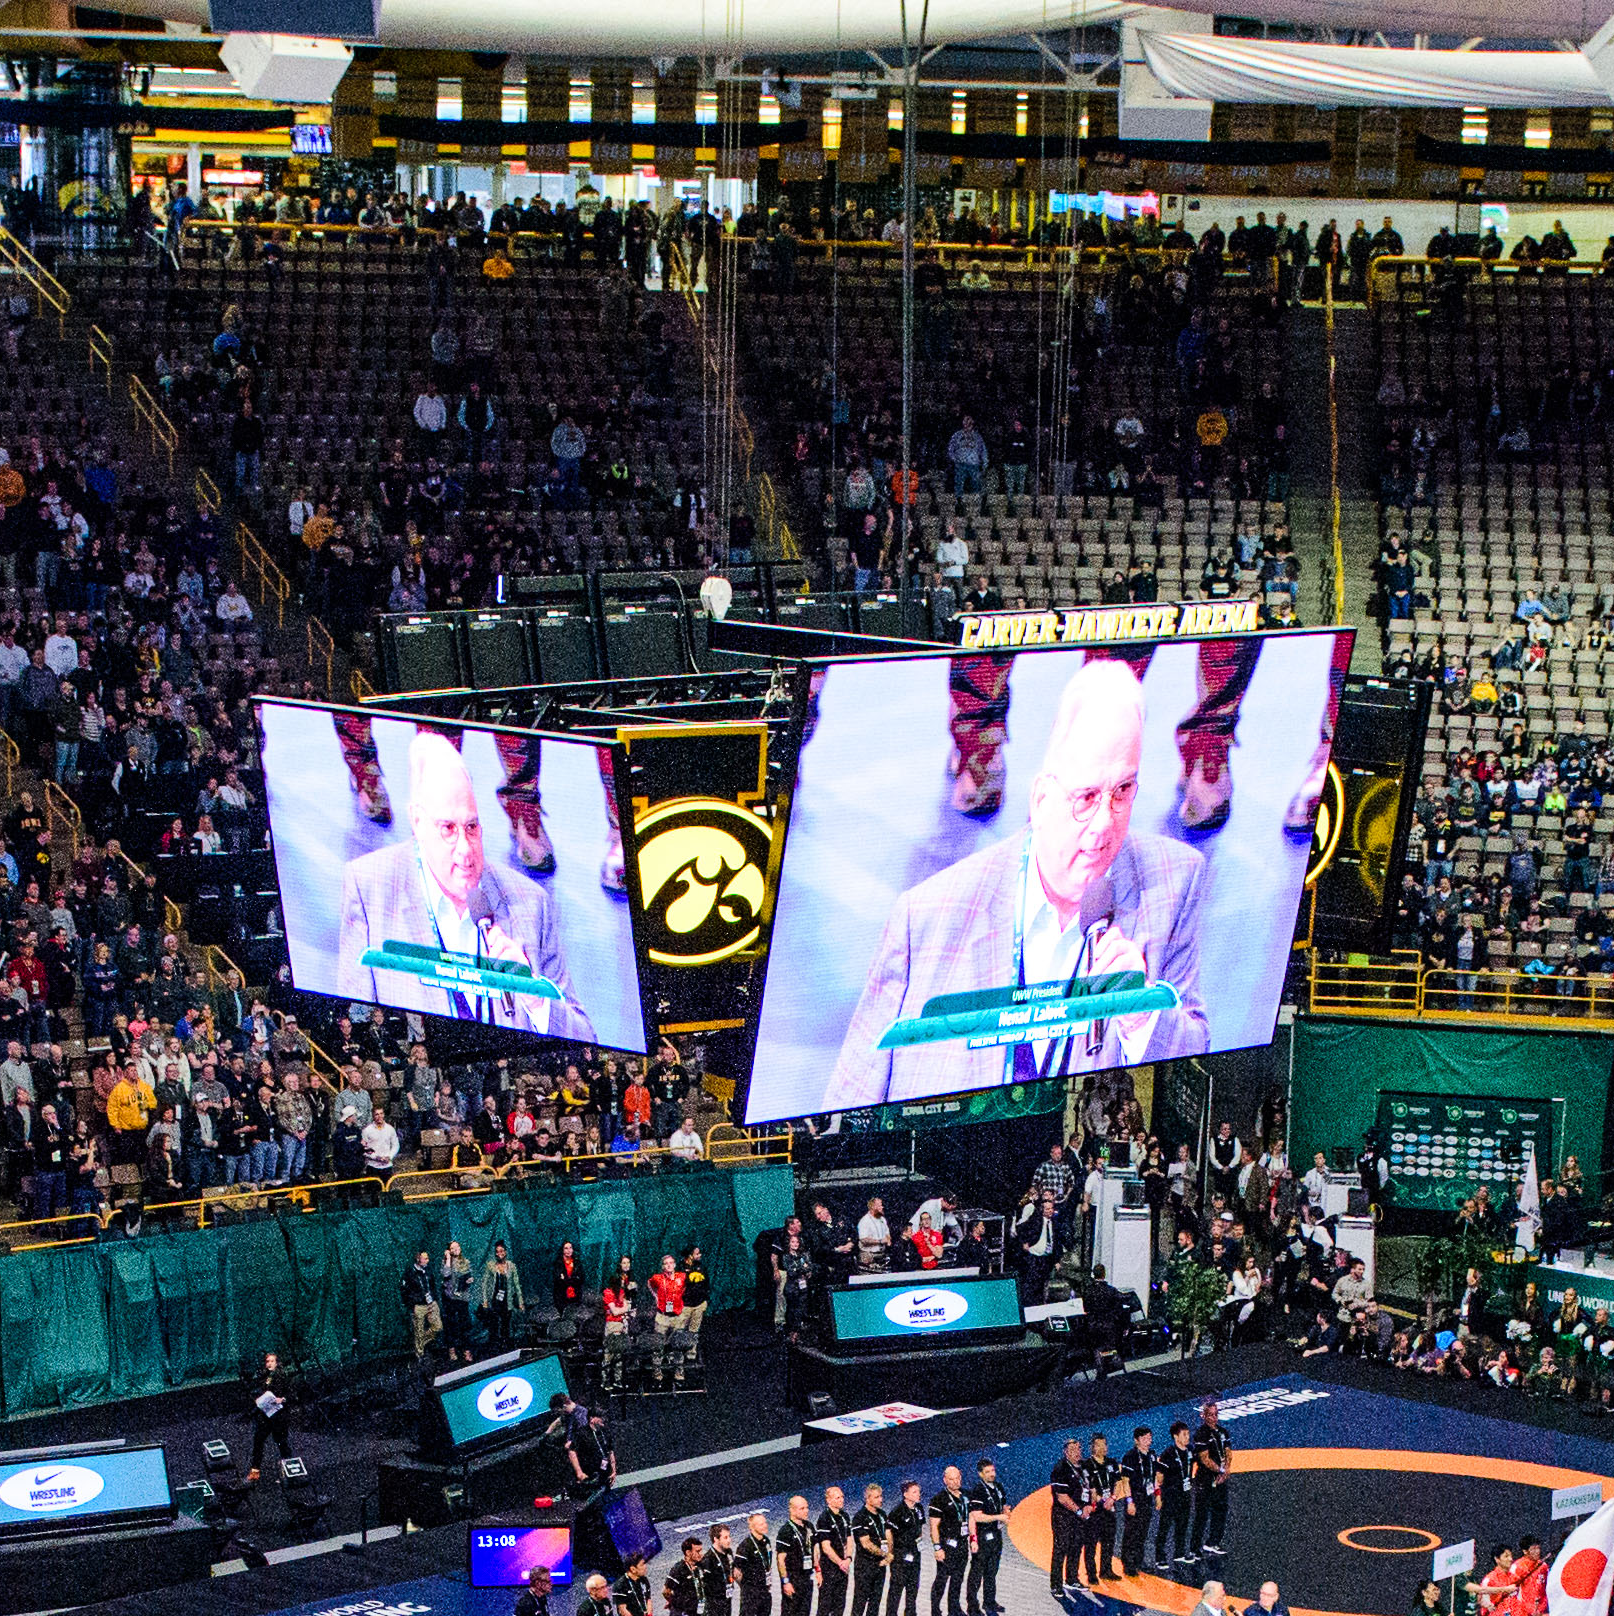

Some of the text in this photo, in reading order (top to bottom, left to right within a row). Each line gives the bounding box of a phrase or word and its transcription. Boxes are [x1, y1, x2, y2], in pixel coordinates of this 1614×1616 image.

[961, 601, 1258, 648] CARVER-HAWKEYE ARENA
[1012, 985, 1064, 1001] UWW President
[29, 1486, 76, 1501] WRESTLING
[477, 1534, 517, 1548] 13:08
